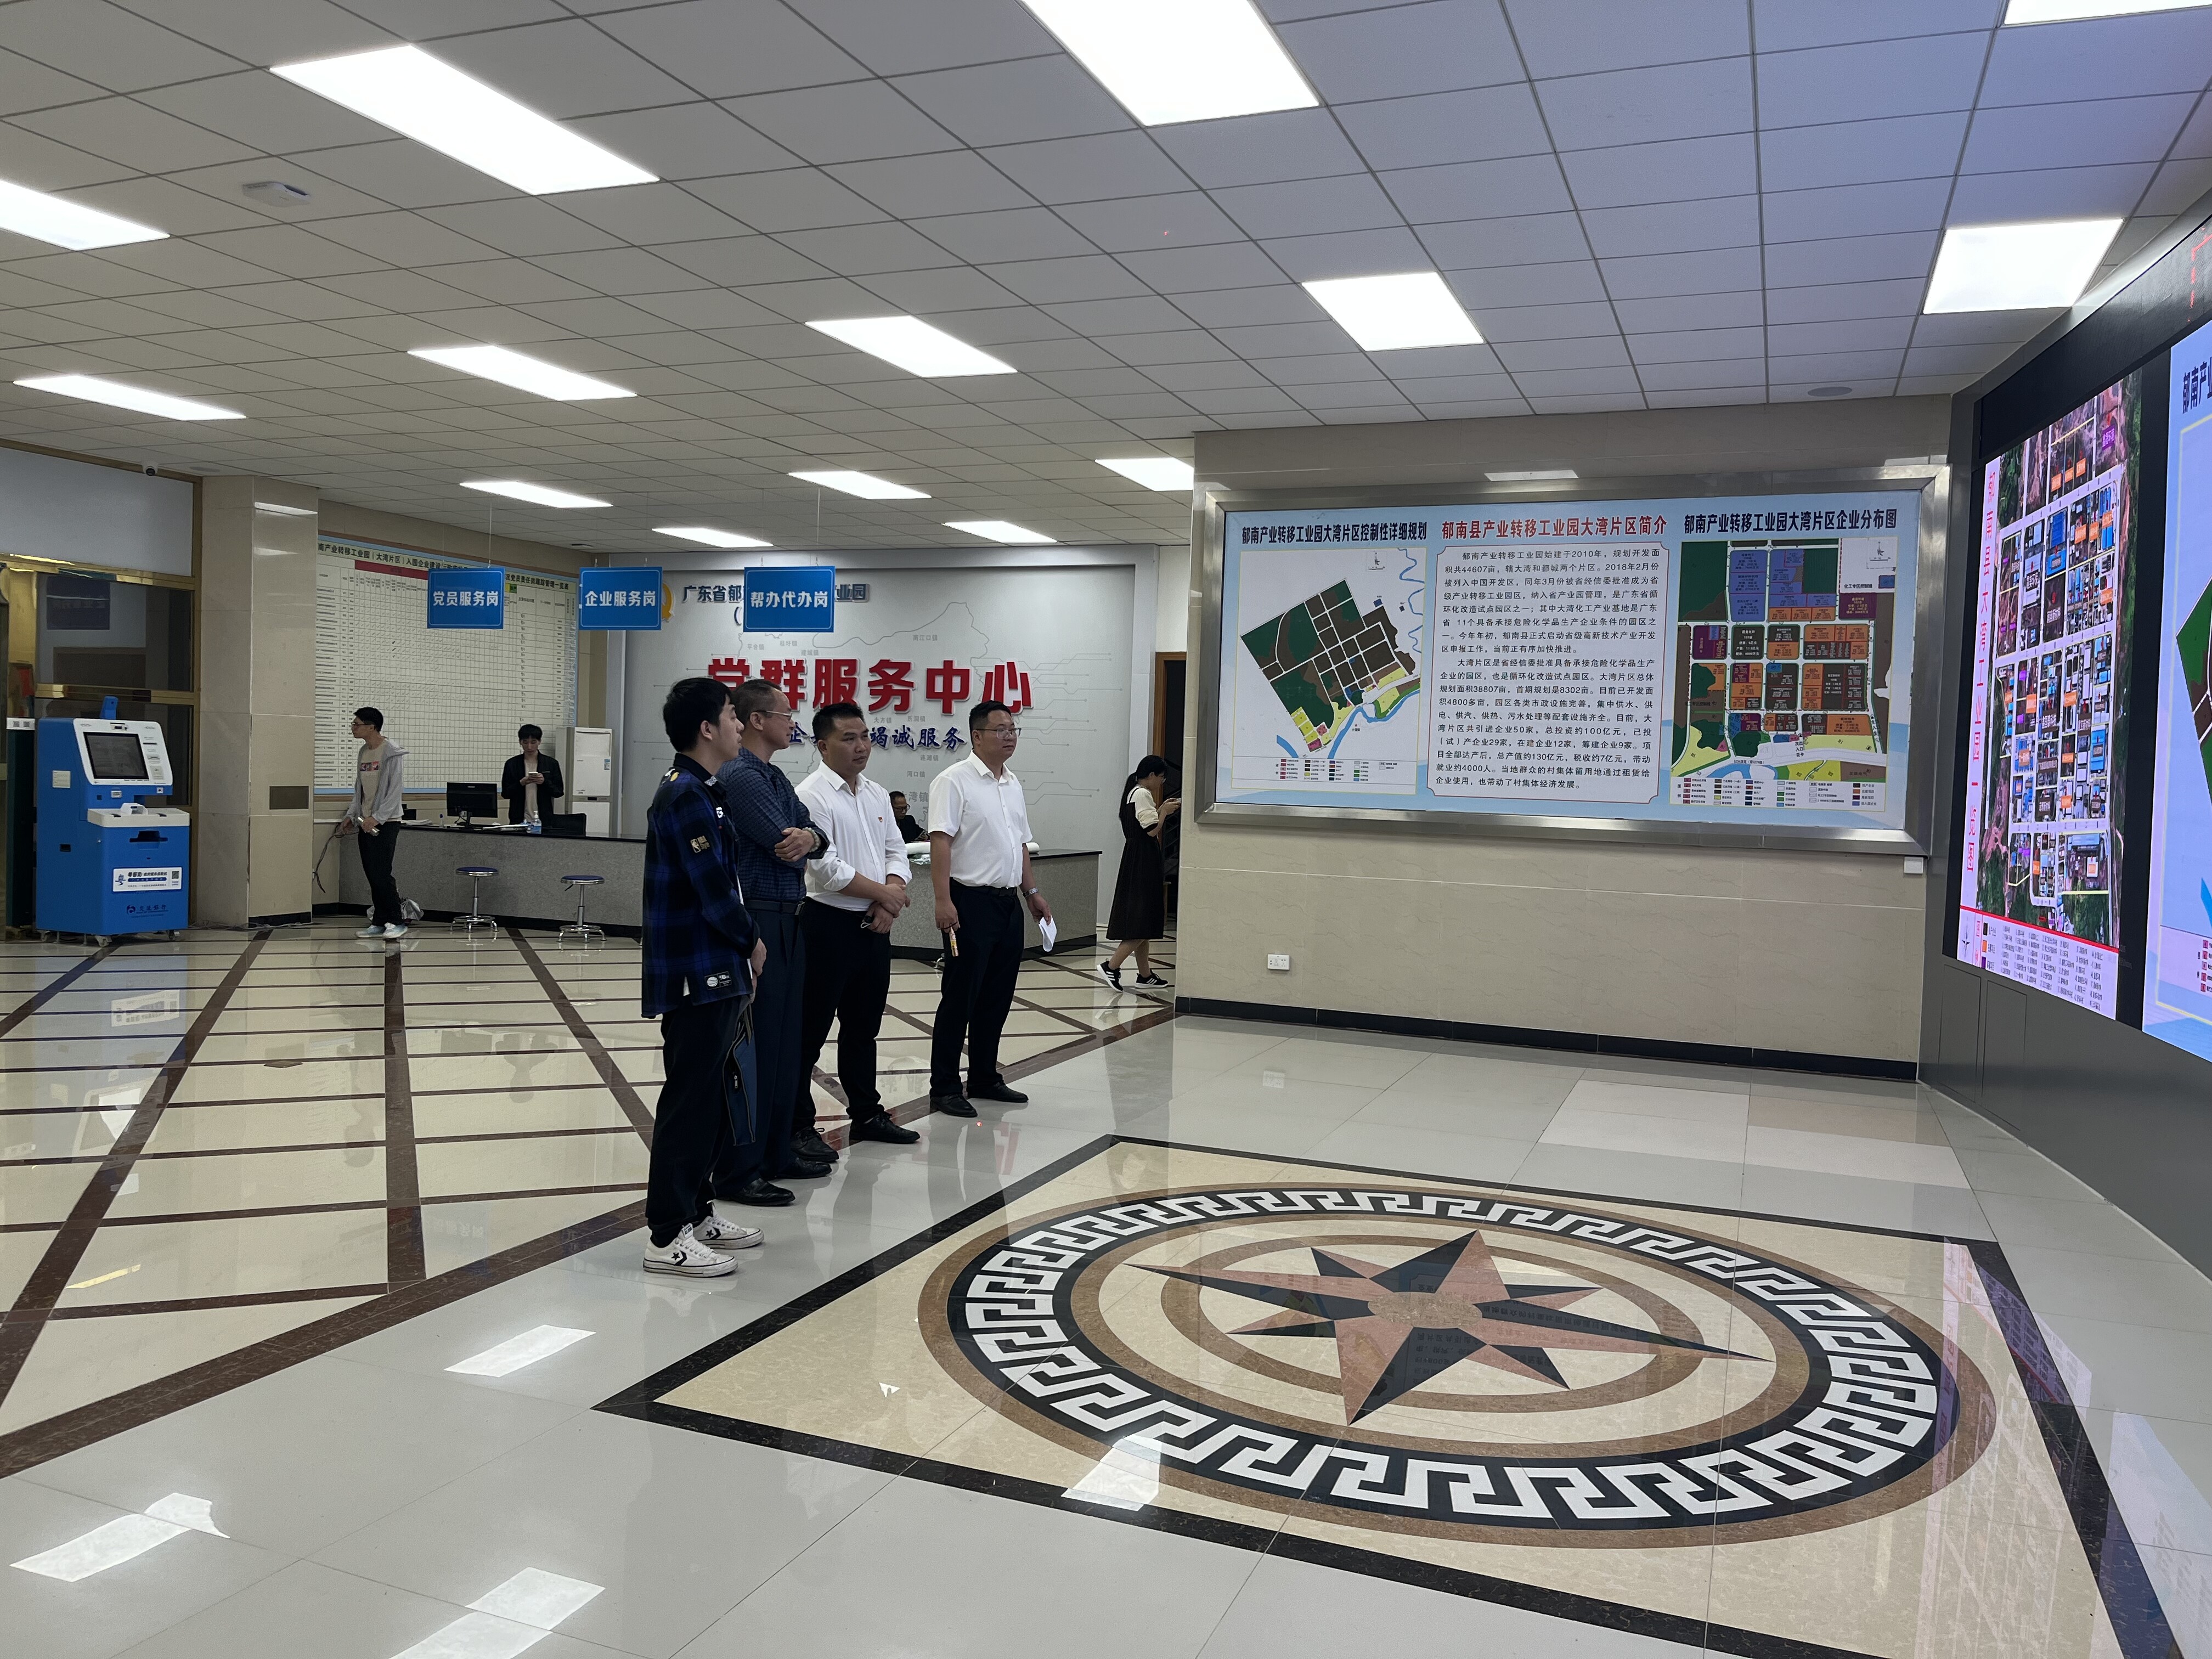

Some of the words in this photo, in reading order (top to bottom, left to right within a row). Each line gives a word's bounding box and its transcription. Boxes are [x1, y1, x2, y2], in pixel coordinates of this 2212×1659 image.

[1442, 515, 1667, 540] 郁南县产业转移工业园大湾片区简介
[1684, 509, 1897, 534] 郁南产业转移工业园大湾片区企业分布图
[1242, 521, 1427, 544] 郁南产业转移工业园大湾片区控制性详细规划
[433, 591, 499, 606] 党员服务岗
[584, 591, 656, 607] 企业服务岗
[751, 591, 828, 608] 帮办代办岗
[1457, 659, 1655, 667] 大湾片区是省经信委批准具备承接危险化学品生产
[707, 657, 1034, 715] 党群服务中心
